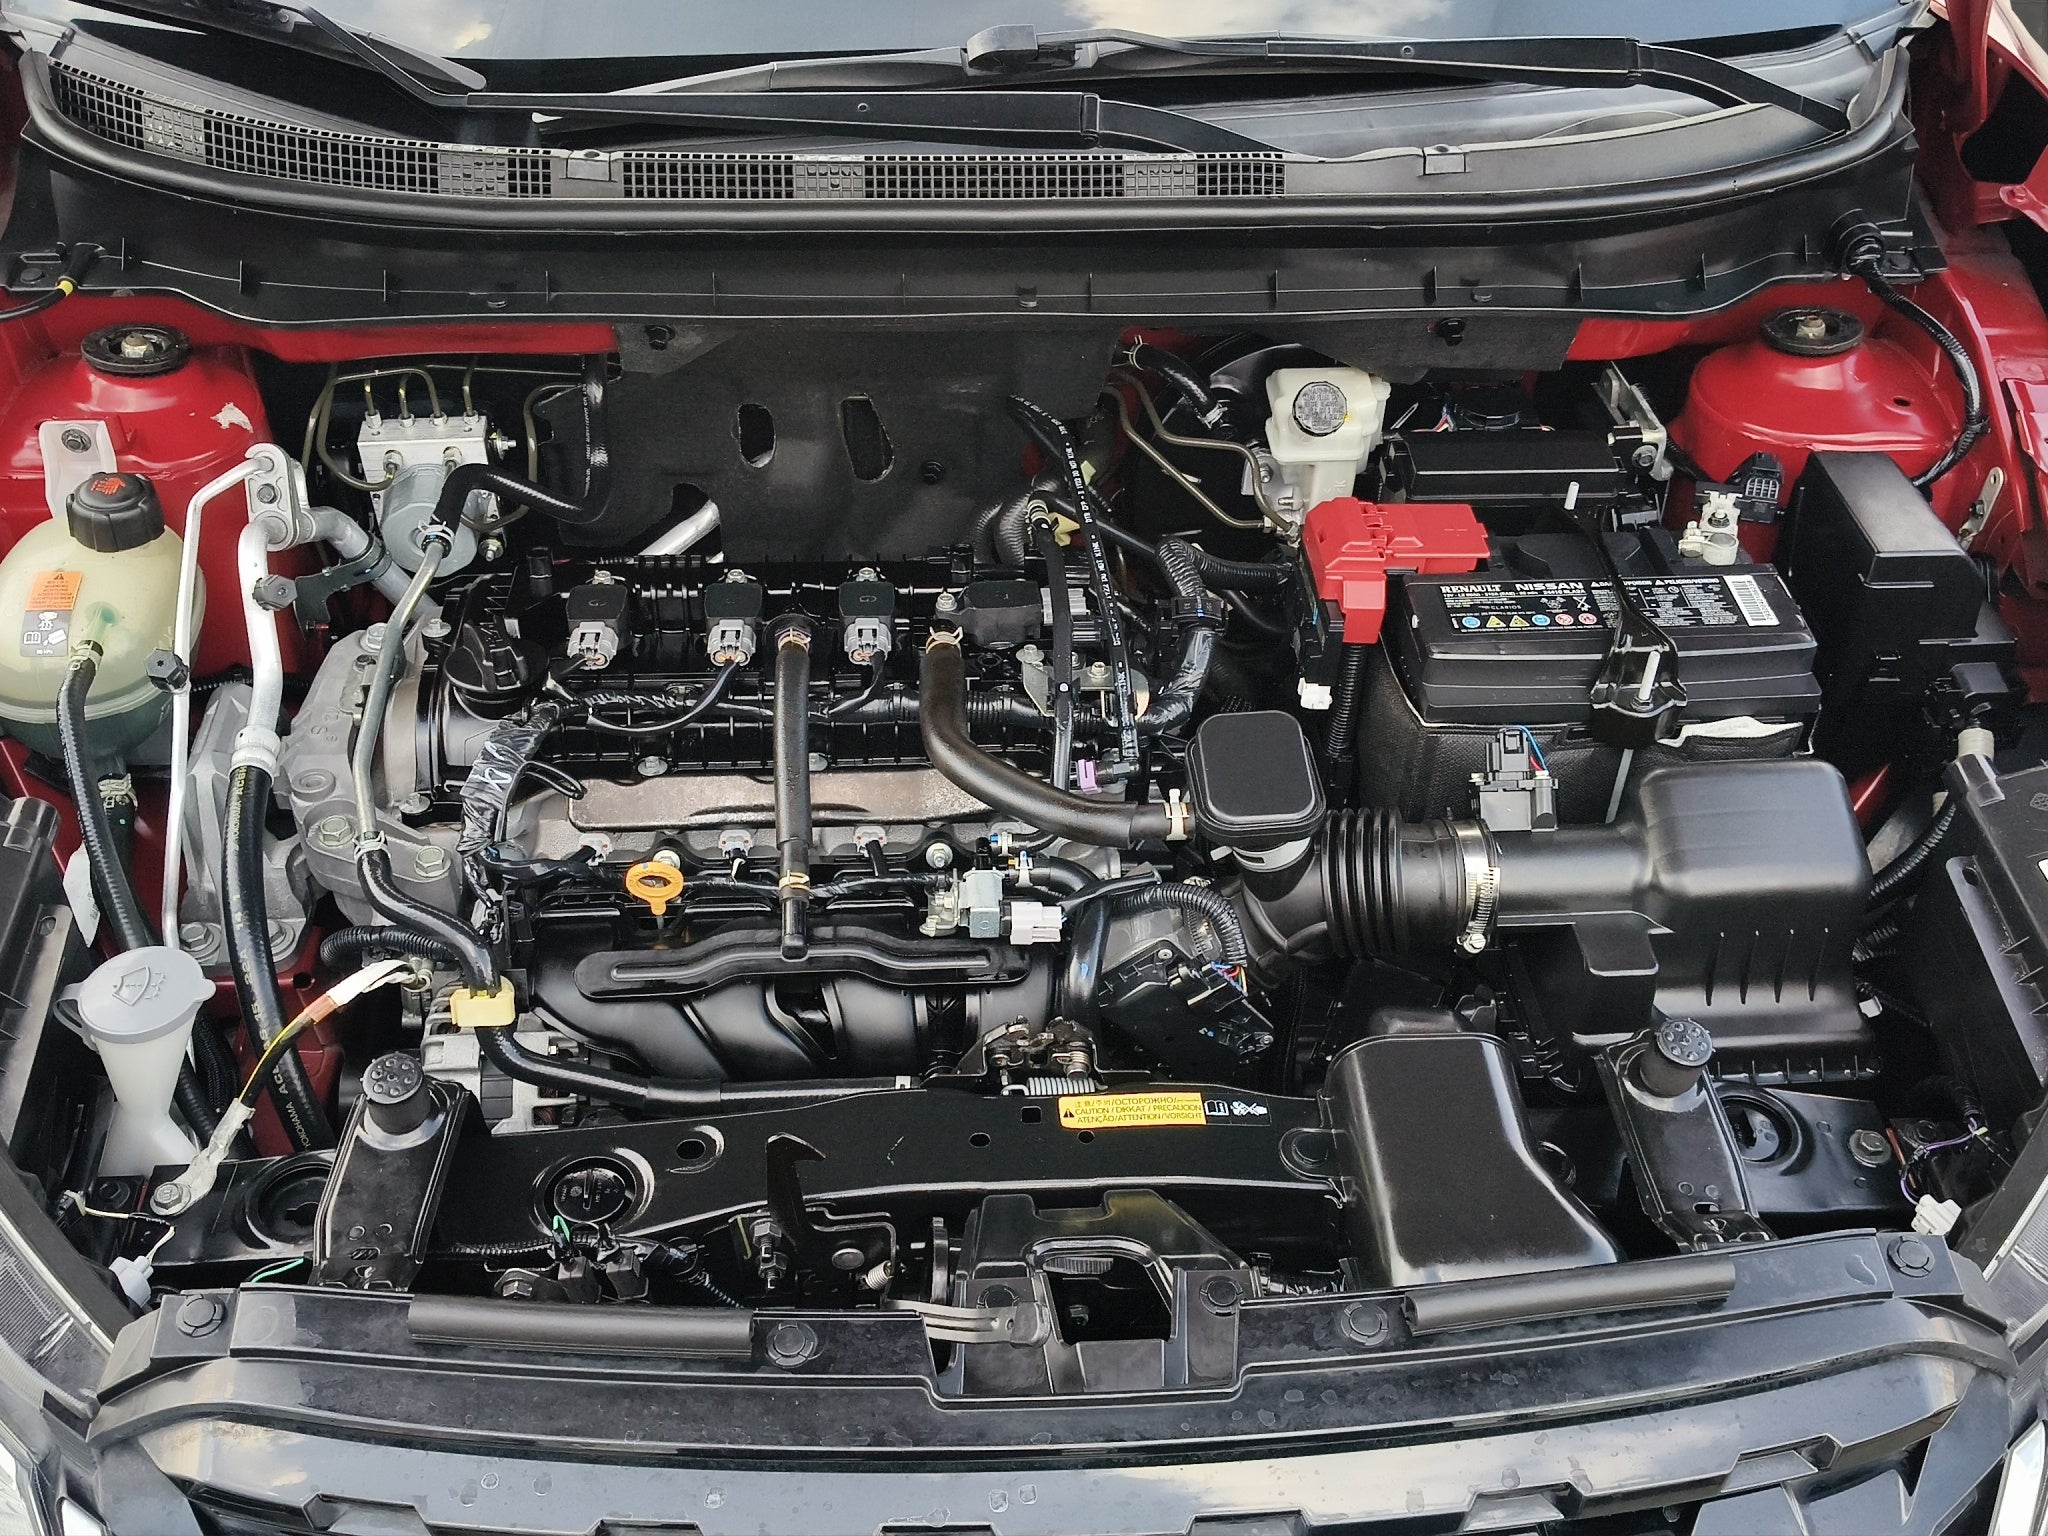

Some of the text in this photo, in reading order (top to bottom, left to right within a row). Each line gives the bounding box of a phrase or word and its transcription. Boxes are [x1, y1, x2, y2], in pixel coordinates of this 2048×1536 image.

[1440, 582, 1584, 593] RENAULT NISSAN
[230, 800, 243, 840] YOKOHAMA
[239, 948, 252, 985] 22A
[285, 1101, 312, 1149] YOKOHAMA
[1075, 1107, 1109, 1115] CAUTION
[1116, 1105, 1145, 1113] DIKKAT
